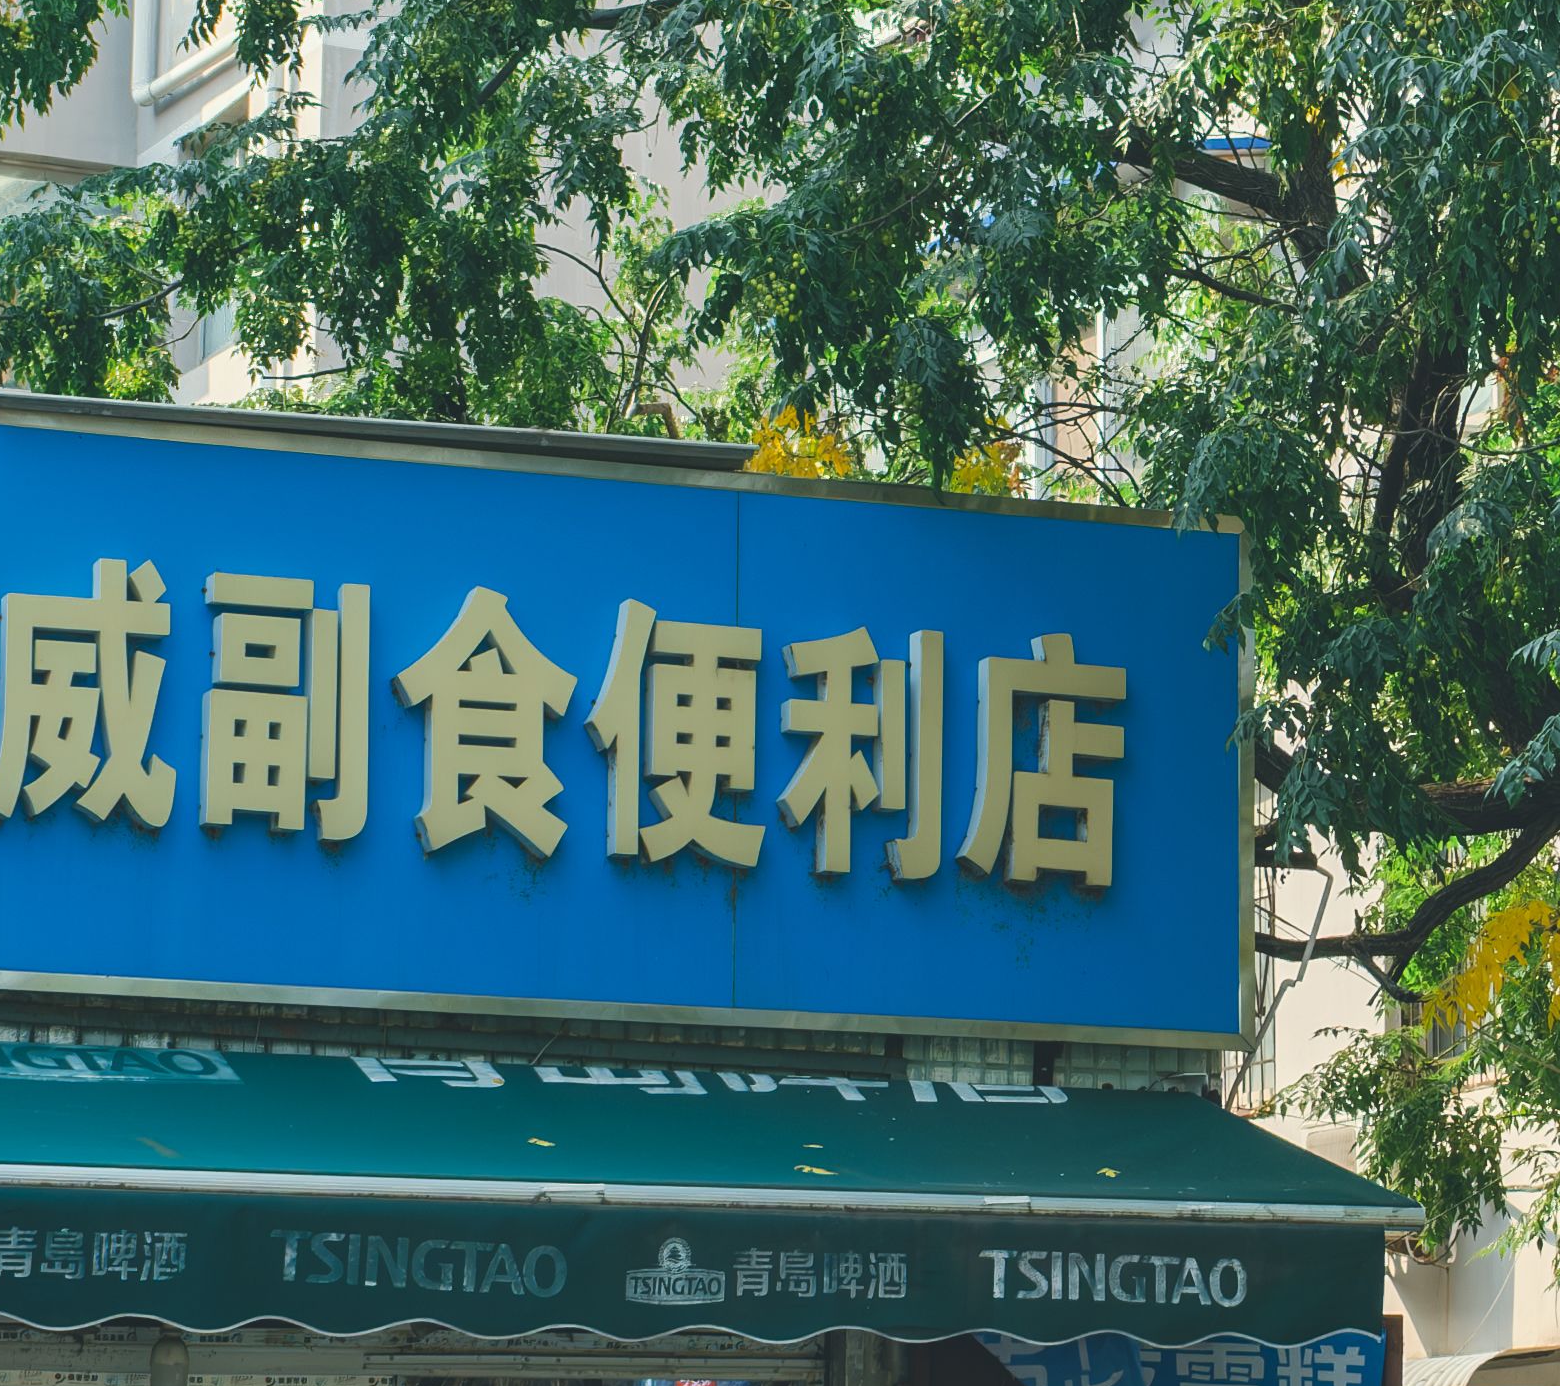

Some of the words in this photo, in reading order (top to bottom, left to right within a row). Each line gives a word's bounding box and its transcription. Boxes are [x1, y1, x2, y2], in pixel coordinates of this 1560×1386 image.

[270, 1228, 568, 1298] TSINGTAO
[628, 1274, 722, 1298] TSINGTAO
[733, 1249, 907, 1301] 青岛啤酒
[979, 1249, 1248, 1308] TSINGTAO
